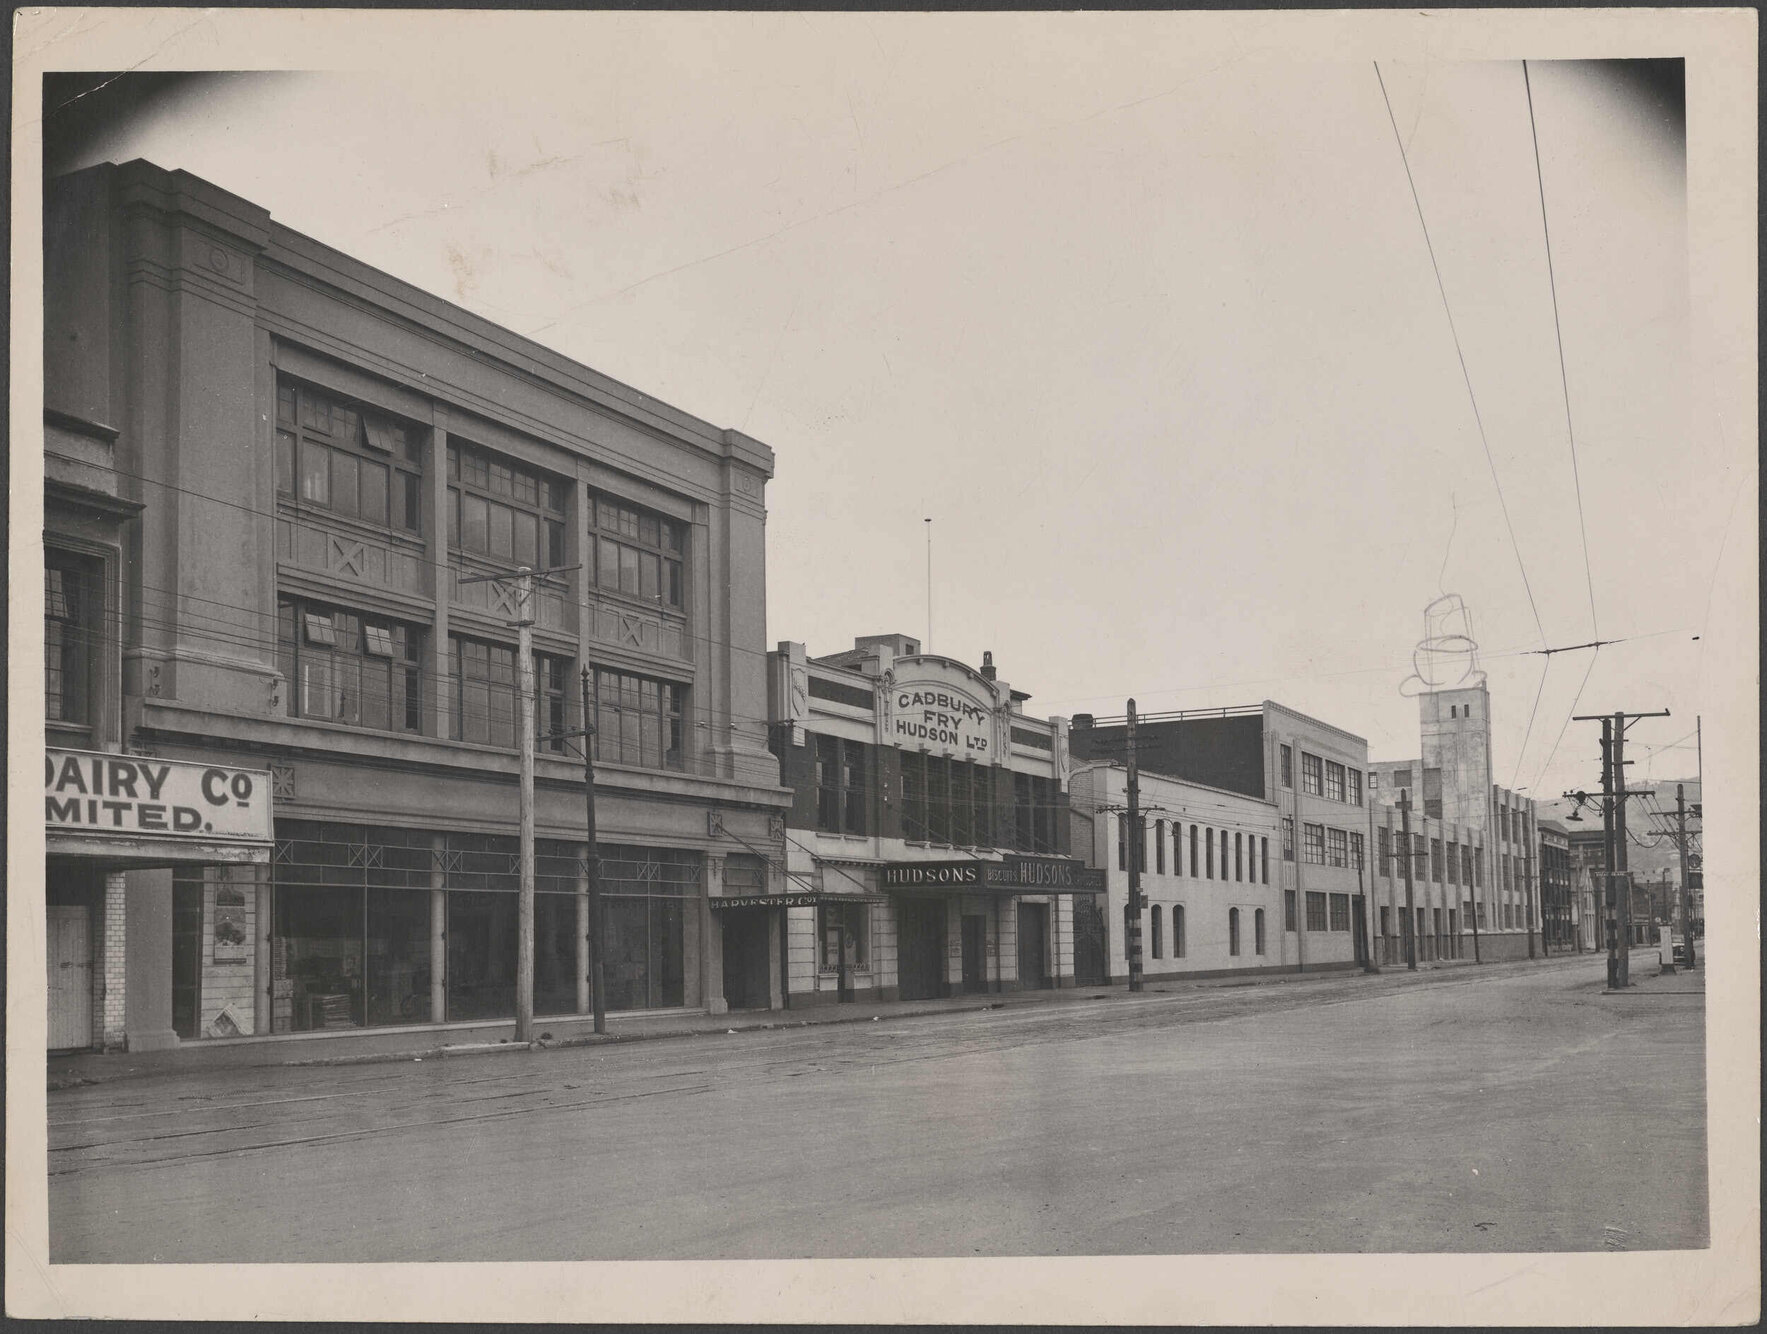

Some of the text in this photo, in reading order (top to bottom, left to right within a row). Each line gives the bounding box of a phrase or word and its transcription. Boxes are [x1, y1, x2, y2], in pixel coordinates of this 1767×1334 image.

[898, 692, 985, 726] CADBURY
[923, 709, 962, 730] FRY
[896, 719, 958, 745] HUDSON
[45, 756, 171, 800] AIRY
[887, 868, 977, 883] HUDSONS
[711, 897, 794, 909] HARVESTER
